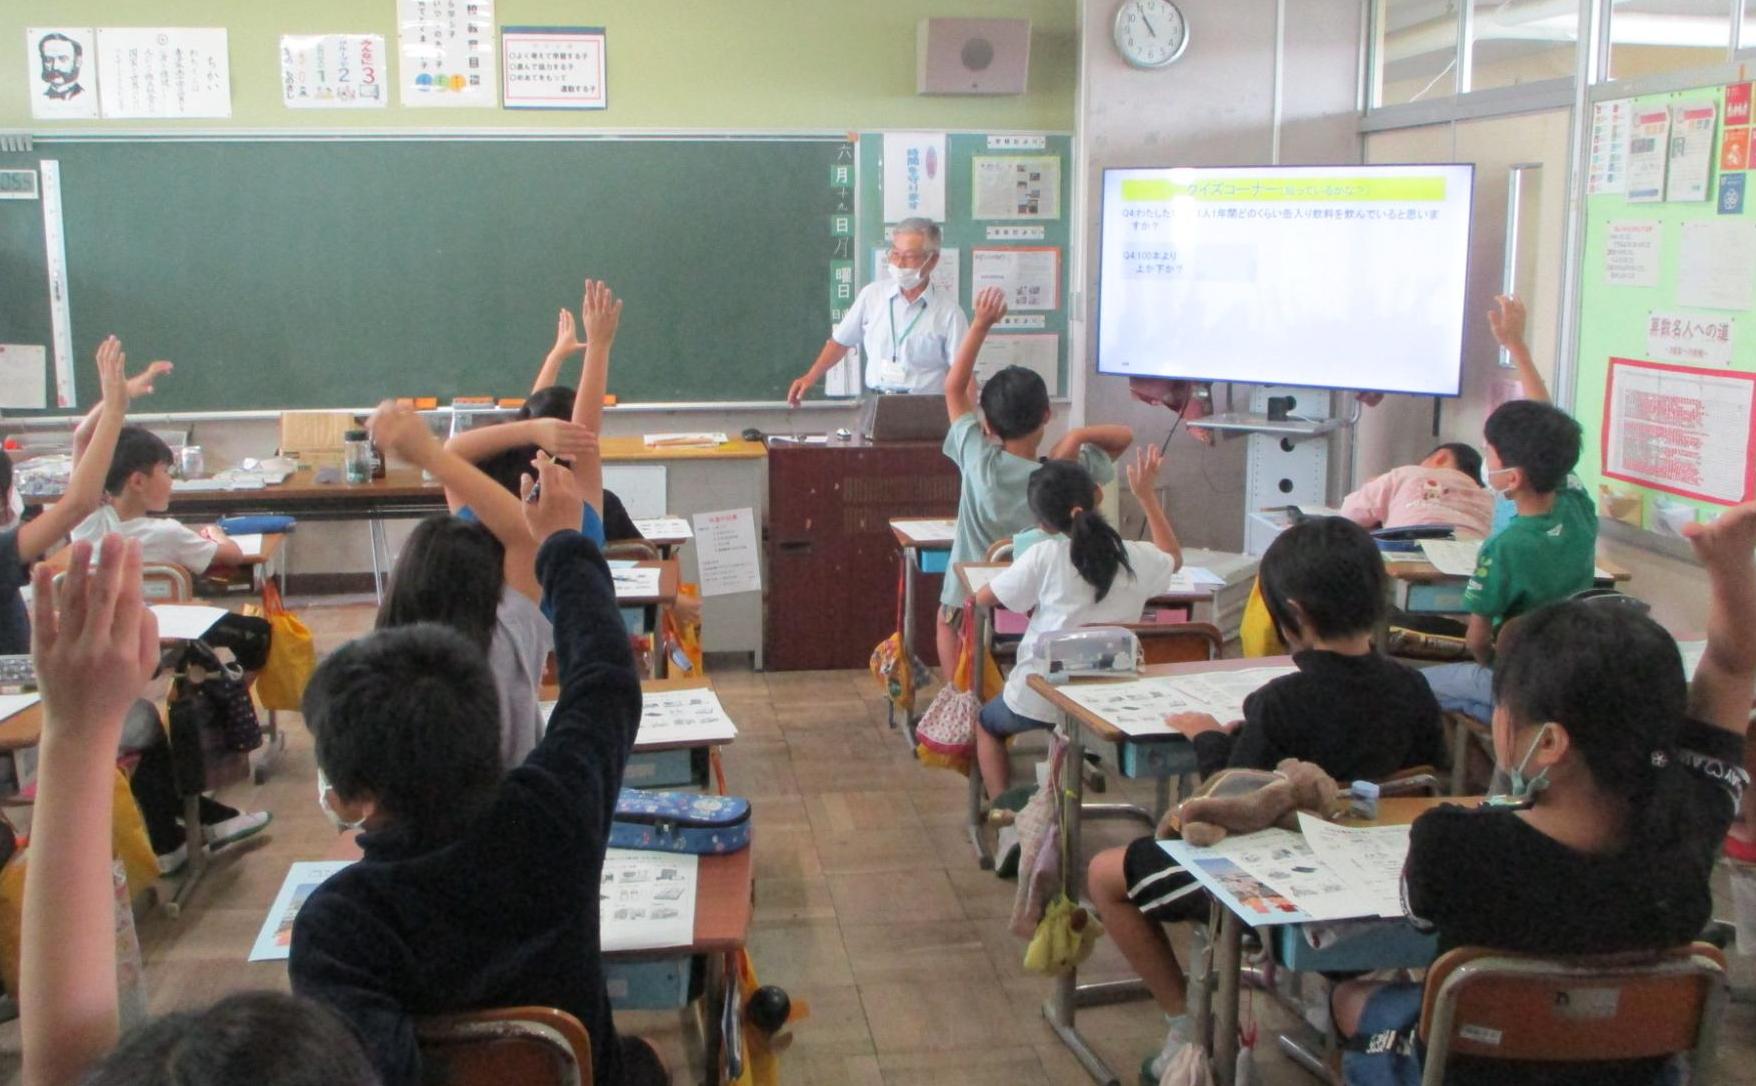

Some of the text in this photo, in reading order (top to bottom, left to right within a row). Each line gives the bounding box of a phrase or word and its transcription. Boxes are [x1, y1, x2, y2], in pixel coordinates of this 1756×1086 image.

[1649, 317, 1729, 341] 算数名人への道
